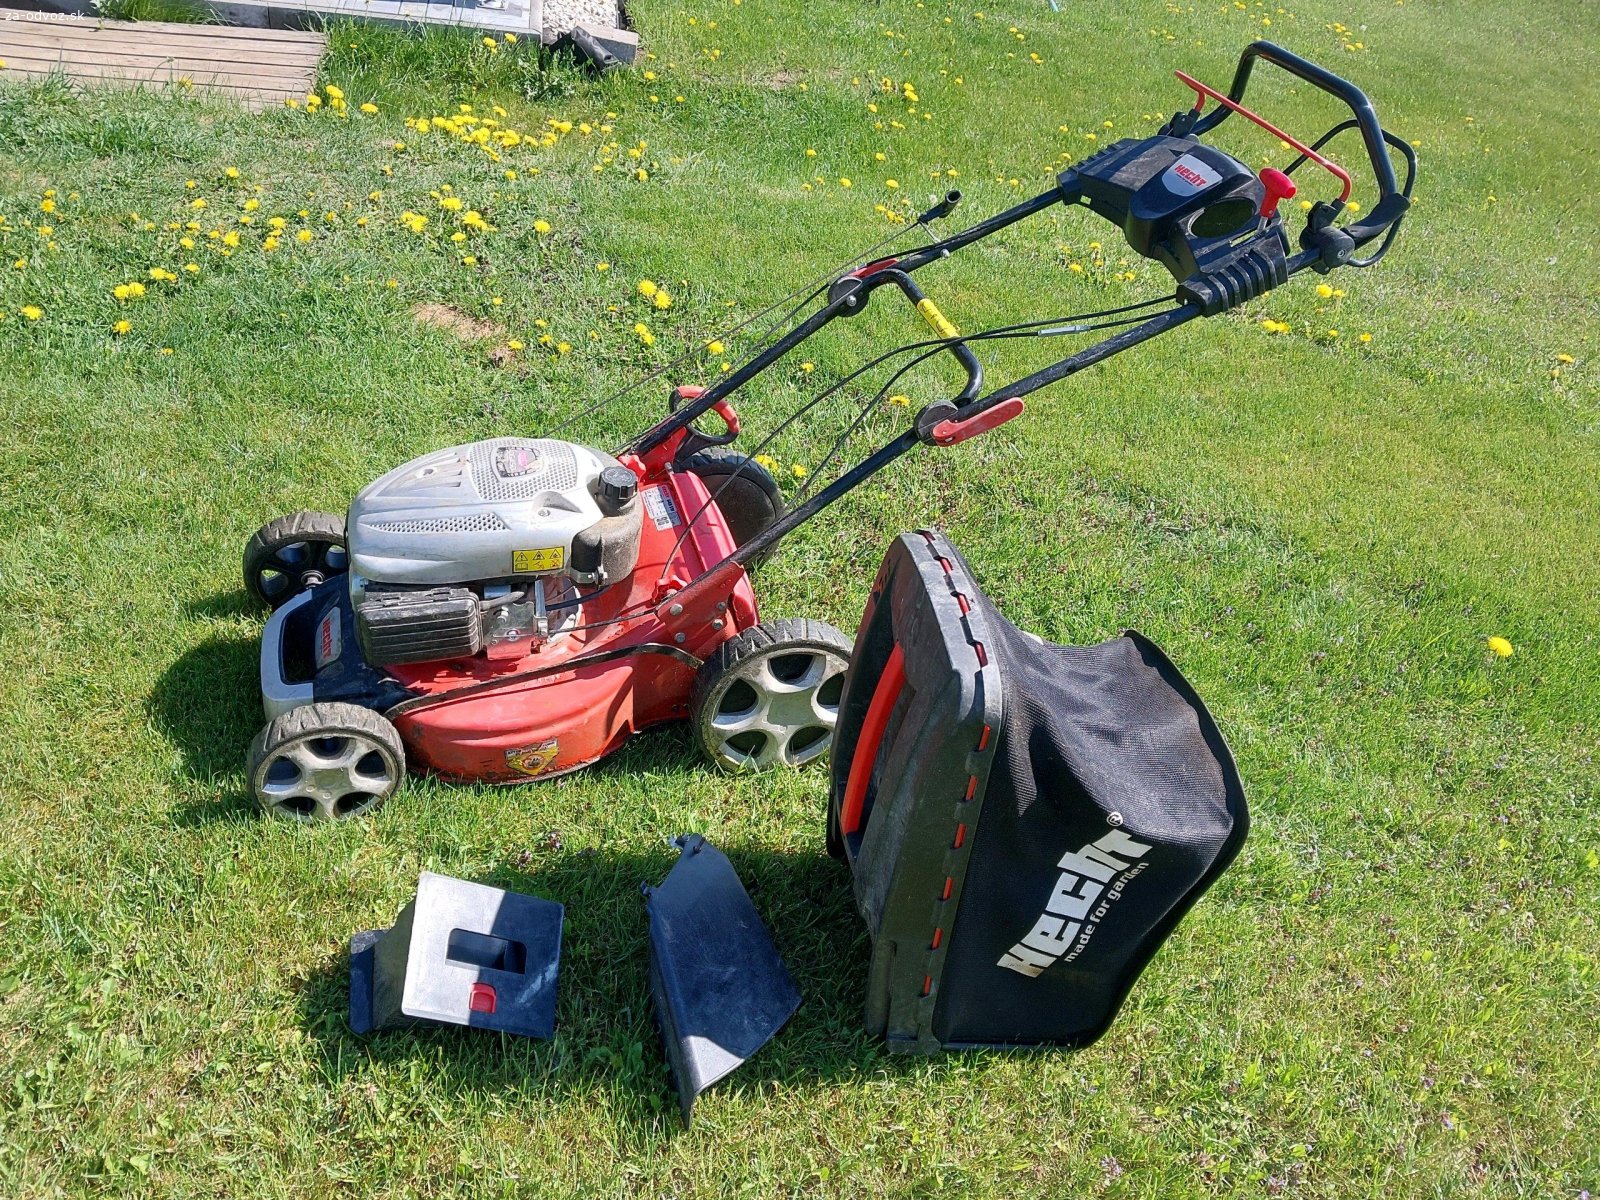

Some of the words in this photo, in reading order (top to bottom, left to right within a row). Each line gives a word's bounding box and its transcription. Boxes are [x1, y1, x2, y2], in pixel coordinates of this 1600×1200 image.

[1064, 924, 1095, 963] made
[1089, 899, 1111, 923] for
[1108, 862, 1149, 901] garden
